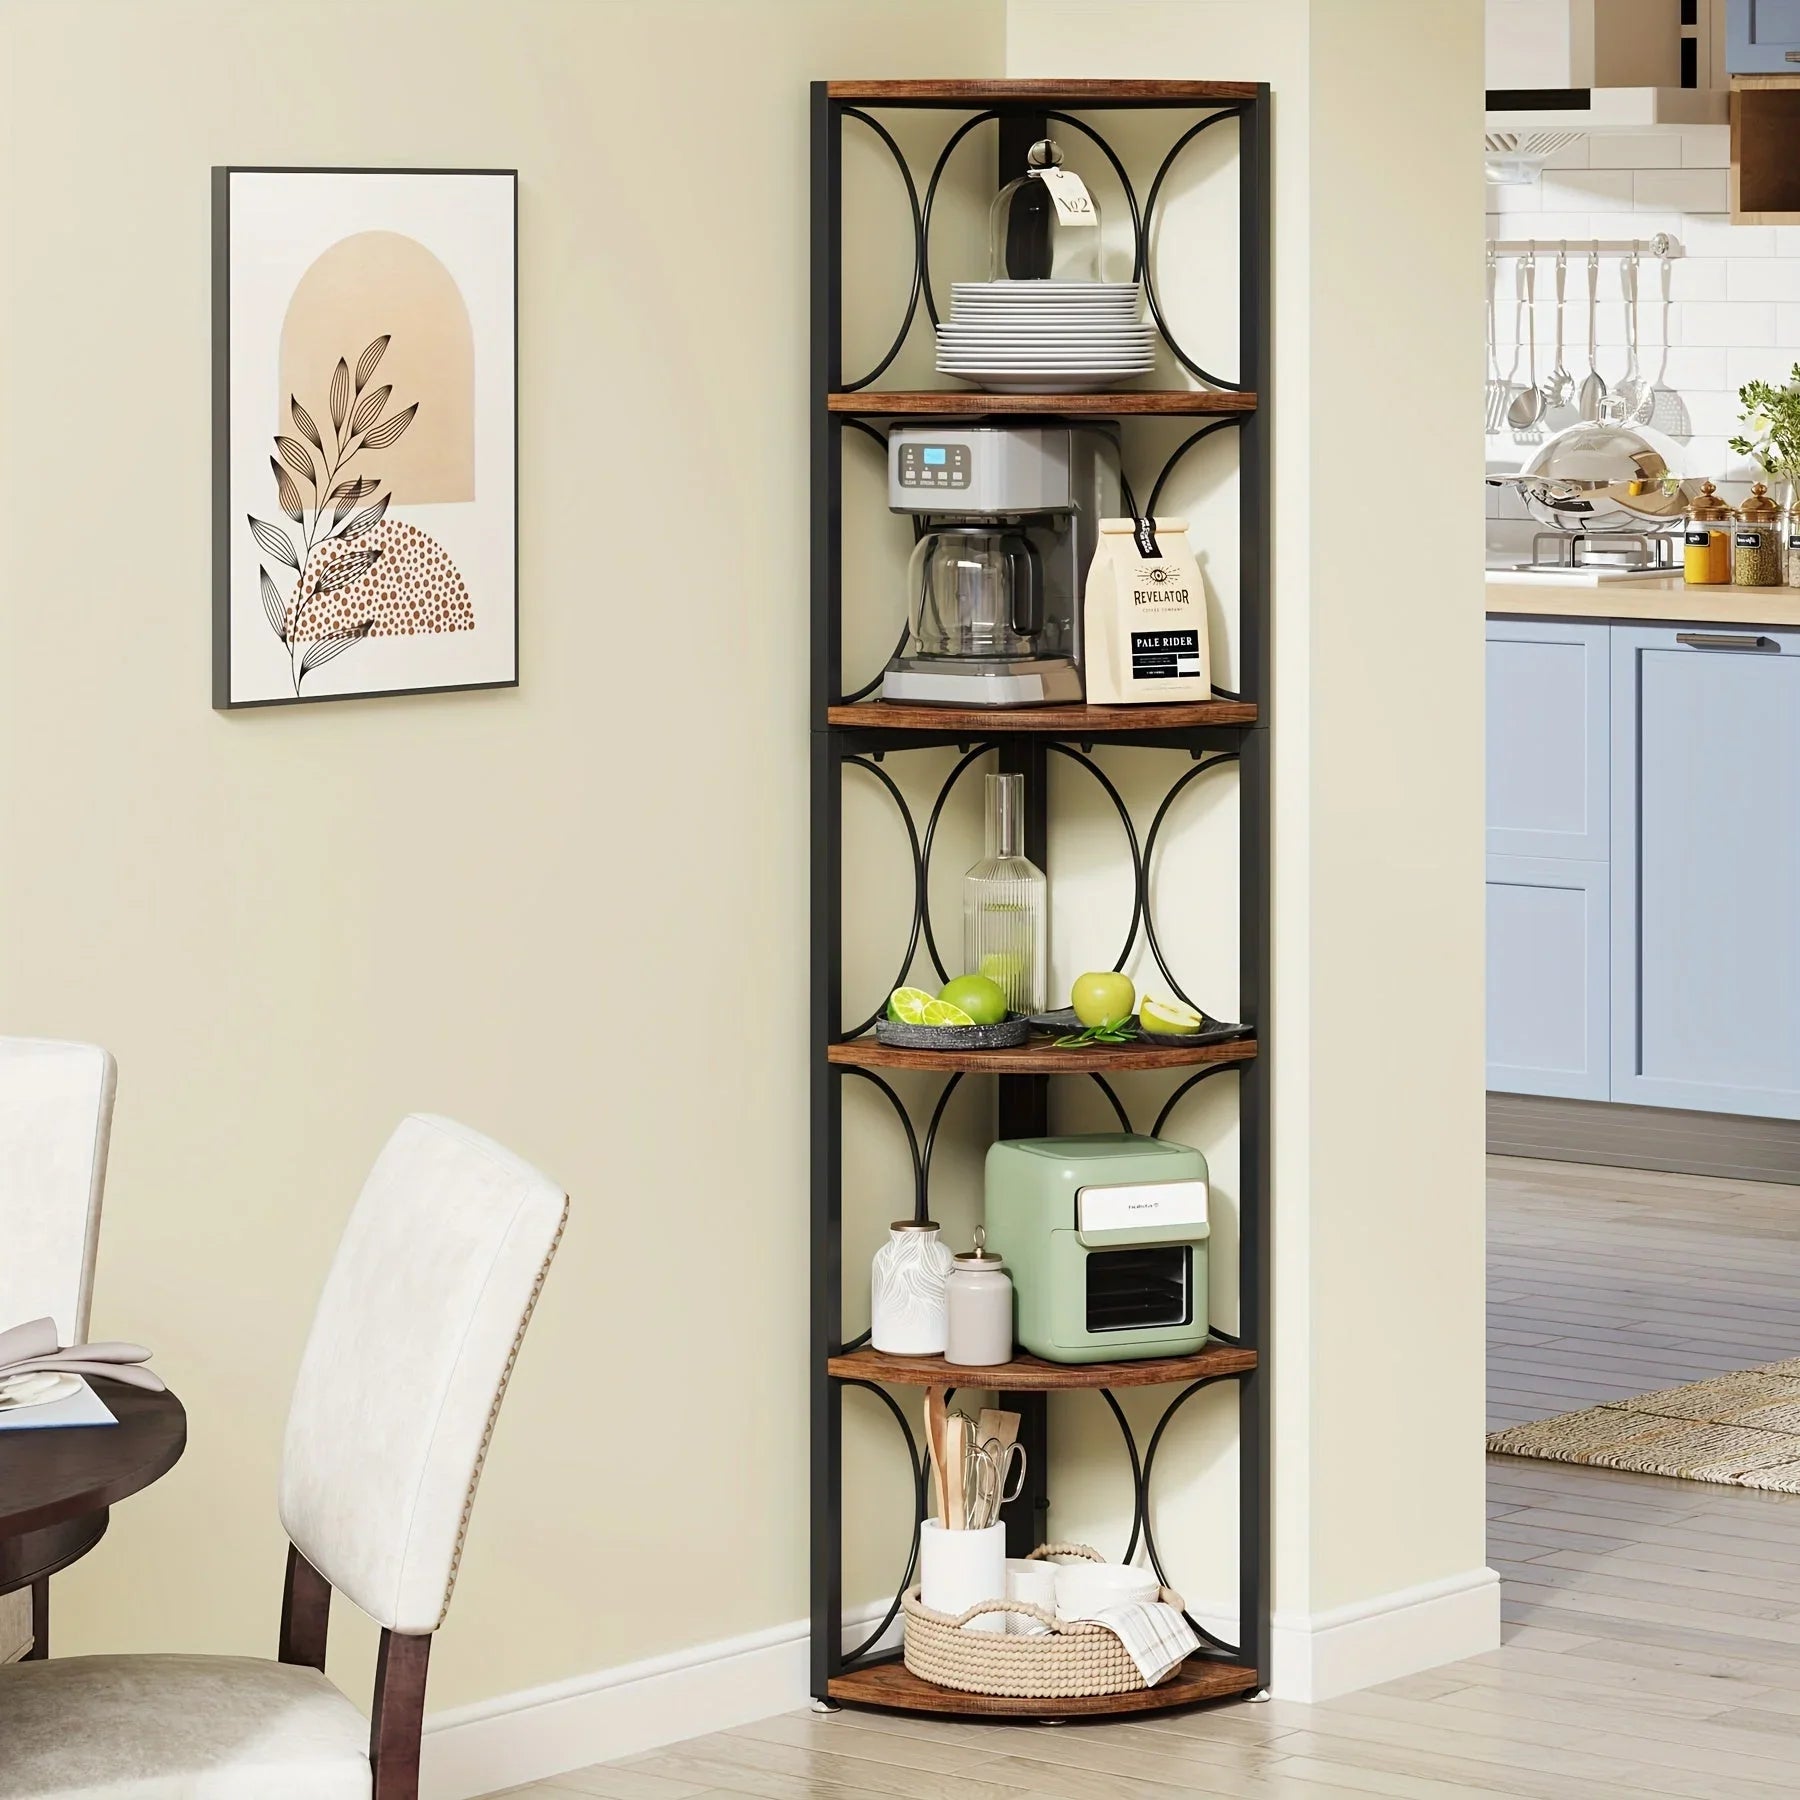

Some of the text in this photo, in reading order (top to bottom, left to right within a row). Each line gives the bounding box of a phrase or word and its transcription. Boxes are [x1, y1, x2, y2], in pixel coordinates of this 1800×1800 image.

[1134, 589, 1189, 605] REVELATOR
[1136, 636, 1193, 648] PALE RIDER
